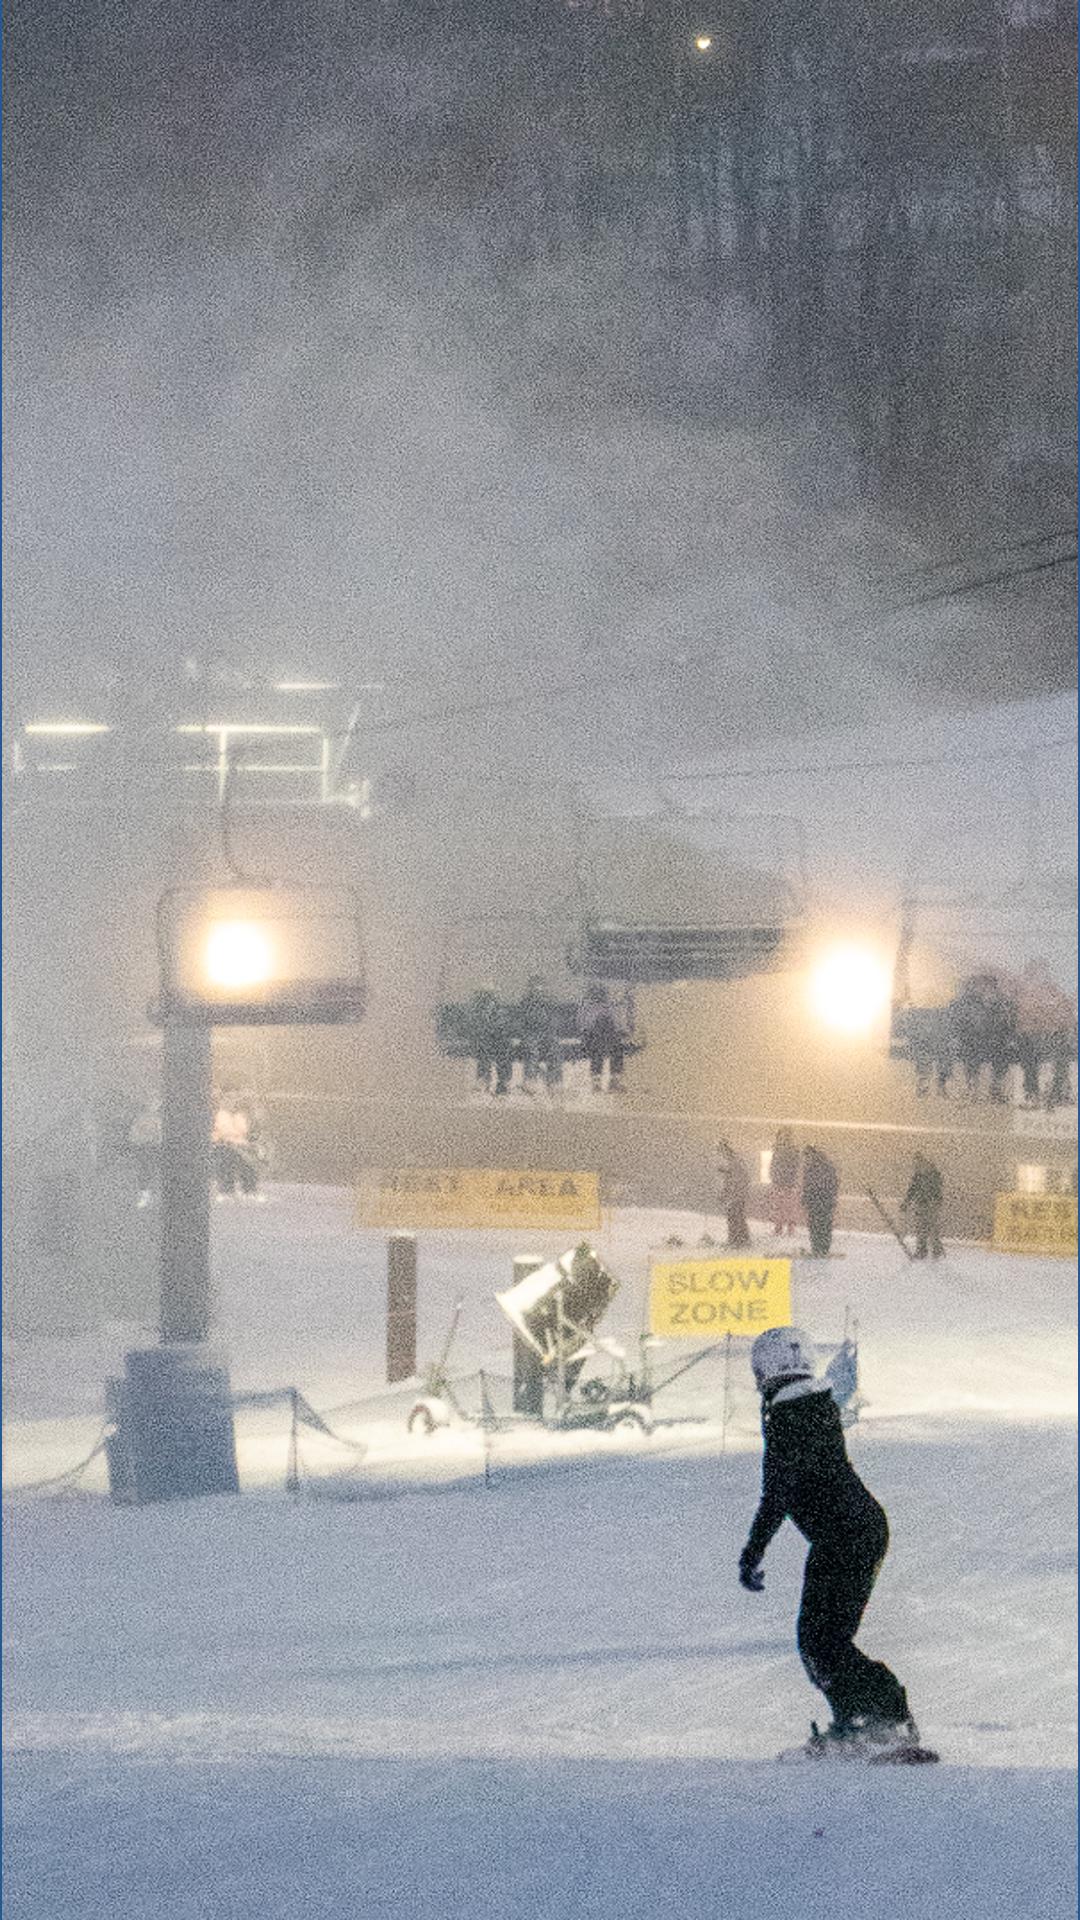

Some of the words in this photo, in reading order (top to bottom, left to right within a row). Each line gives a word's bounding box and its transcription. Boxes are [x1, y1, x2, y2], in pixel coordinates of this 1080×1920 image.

[495, 1176, 579, 1197] AREA
[667, 1269, 770, 1295] SLOW
[668, 1299, 769, 1324] ZONE
